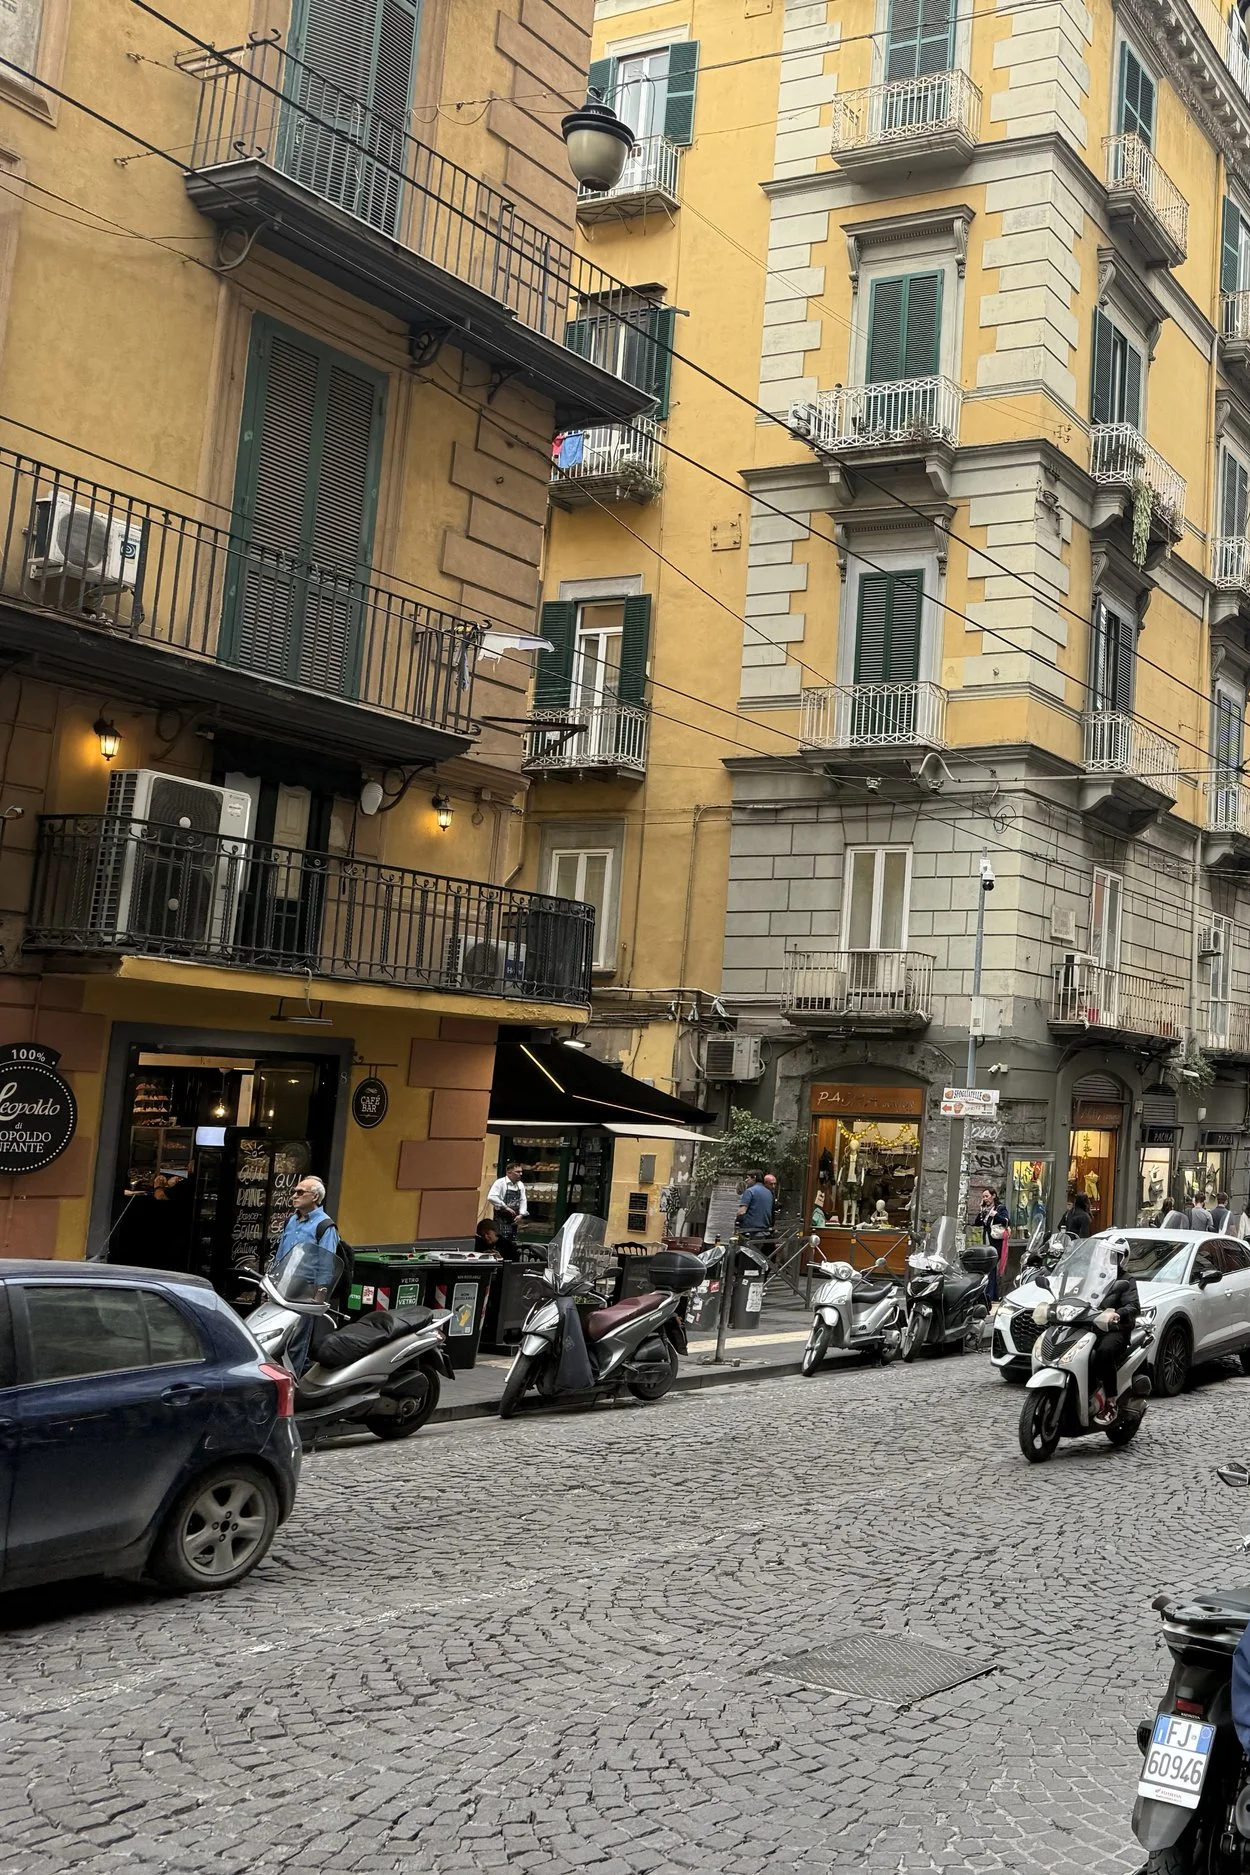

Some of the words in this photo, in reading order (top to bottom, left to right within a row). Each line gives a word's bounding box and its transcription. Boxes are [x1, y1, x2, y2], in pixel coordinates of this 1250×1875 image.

[11, 1049, 46, 1061] 100%
[361, 1095, 381, 1105] CAFÉ
[361, 1104, 377, 1113] BAR
[1166, 1720, 1193, 1748] FJ
[1147, 1750, 1204, 1786] 60946
